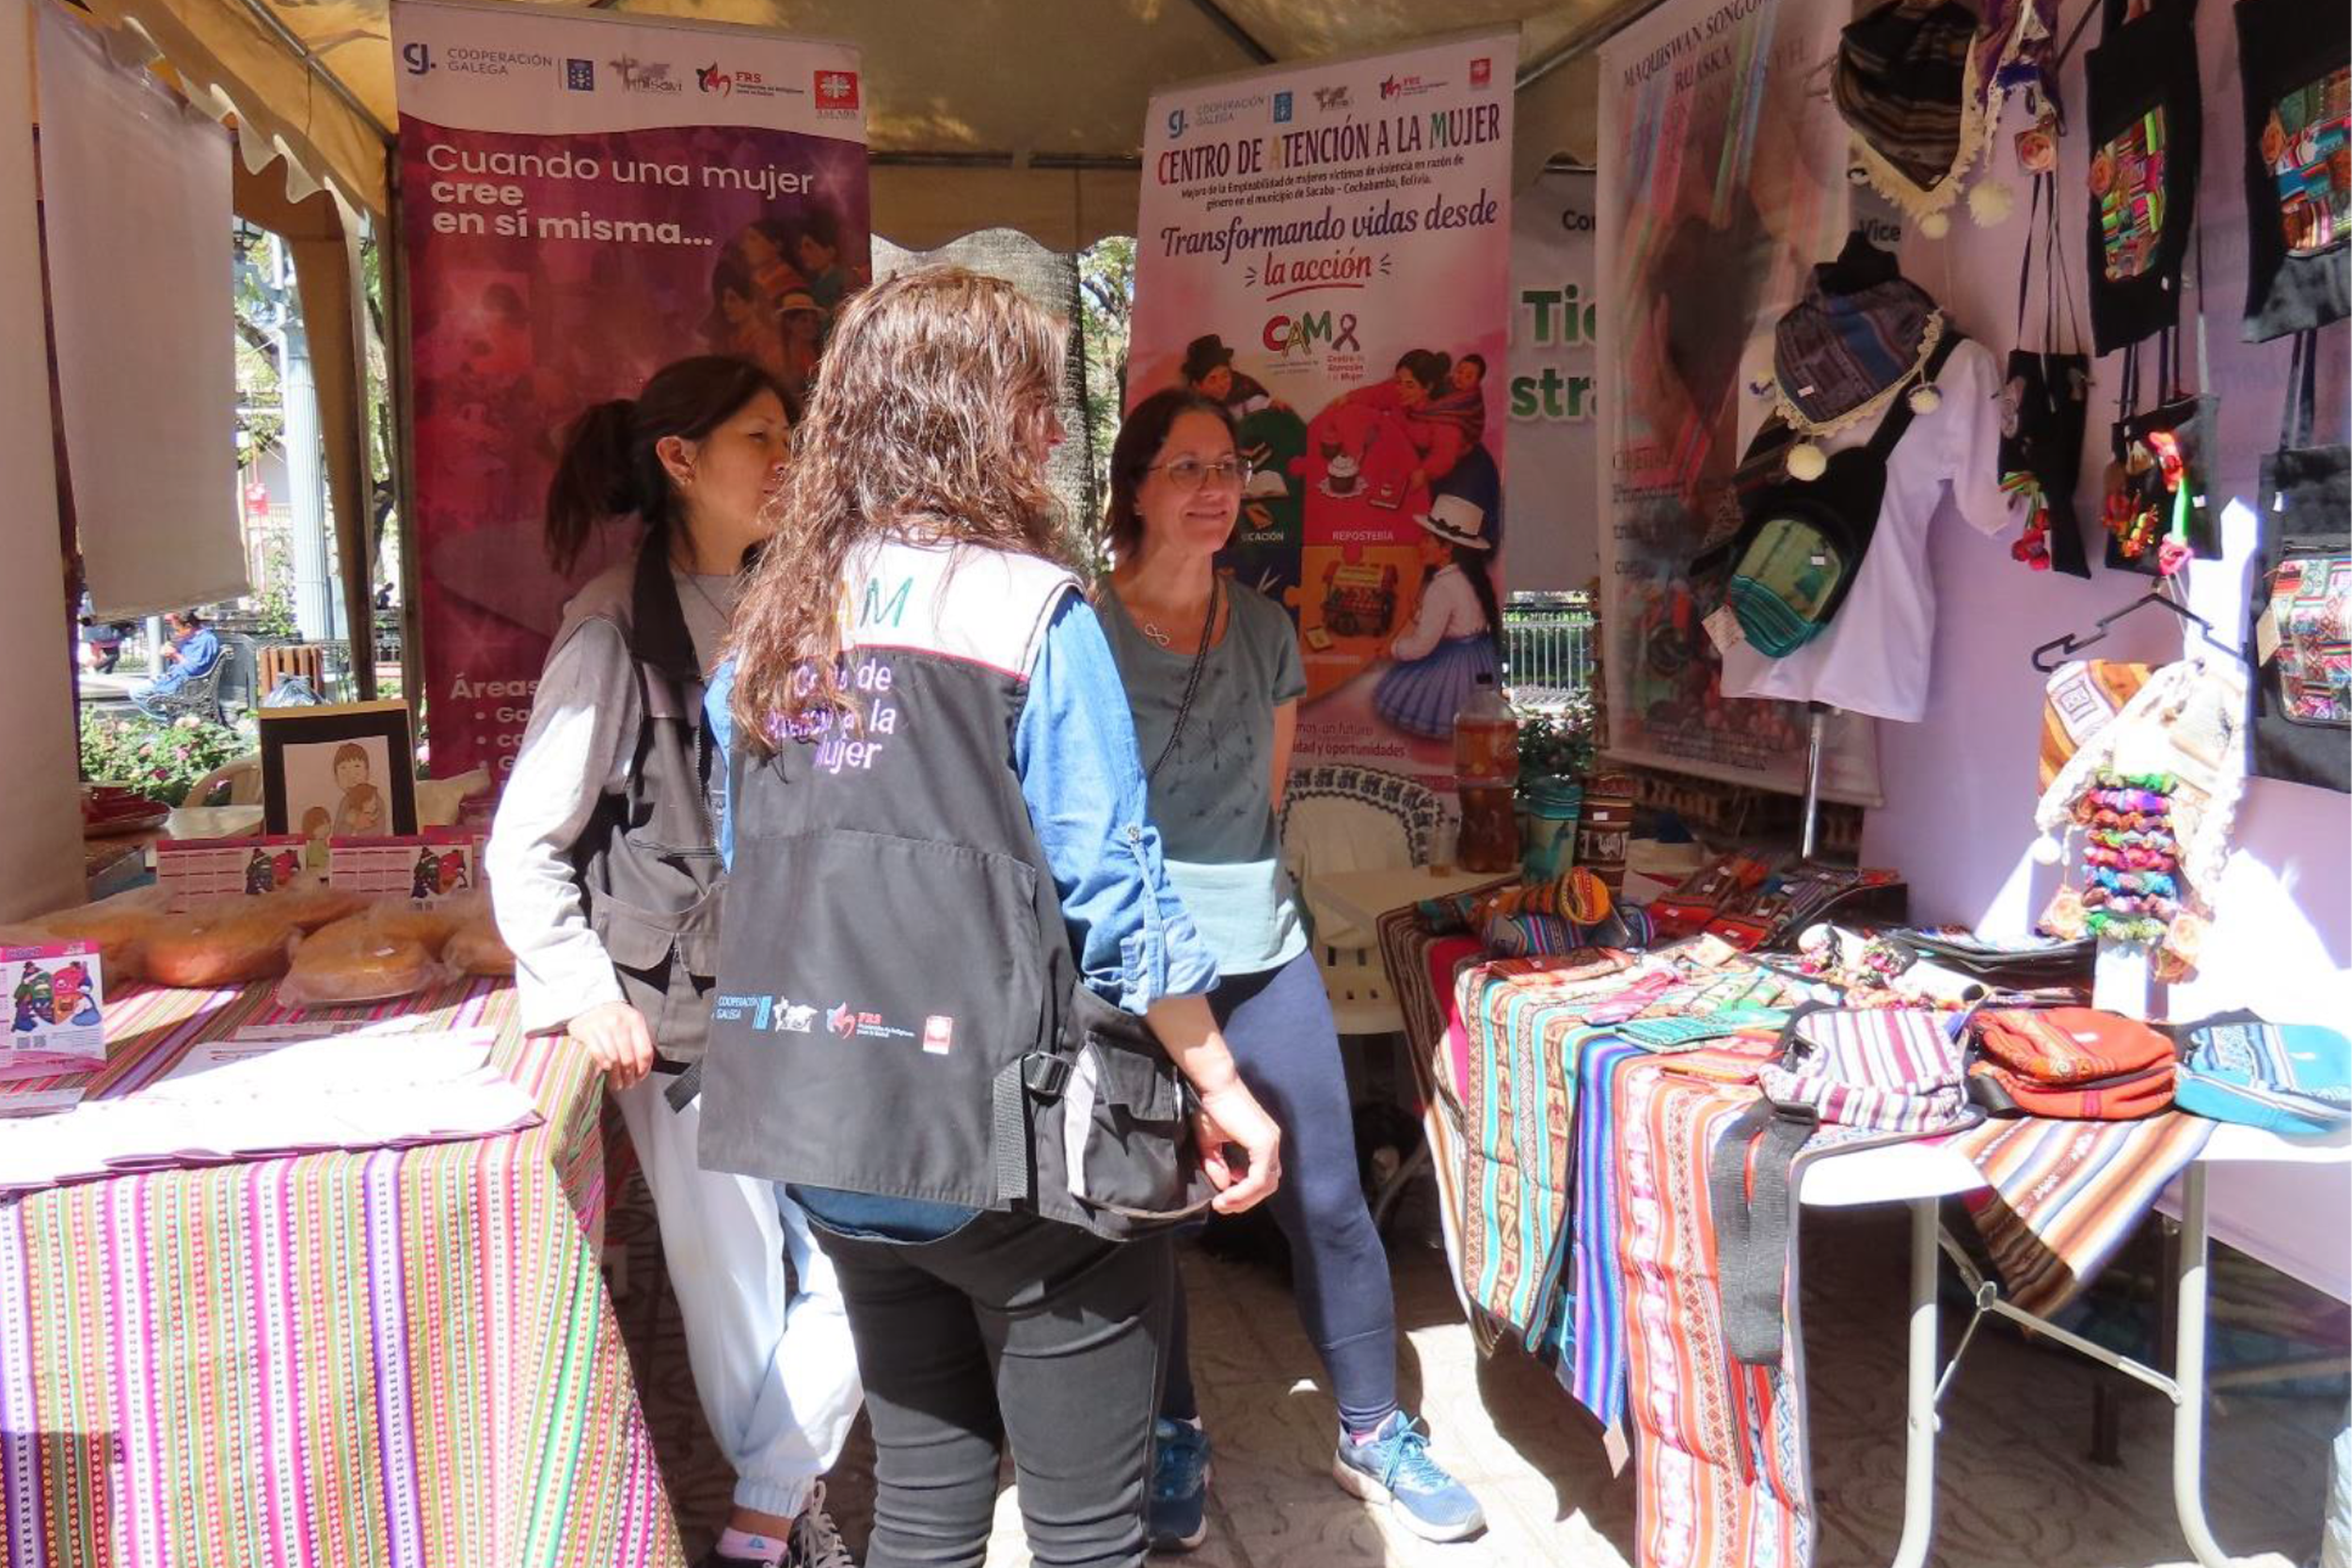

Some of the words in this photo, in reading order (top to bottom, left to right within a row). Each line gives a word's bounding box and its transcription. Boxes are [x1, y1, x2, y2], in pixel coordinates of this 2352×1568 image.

[447, 48, 553, 67] COOPERACIÓN
[448, 62, 509, 75] GALEGA
[736, 71, 762, 84] FRS
[1158, 142, 1230, 185] CENTRO
[1238, 138, 1263, 175] DE
[1270, 114, 1370, 170] ATENCIÓN
[1376, 119, 1391, 157] A
[1397, 115, 1422, 153] LA
[1430, 103, 1501, 150] MUJER
[426, 144, 600, 180] Cuando
[612, 159, 691, 186] una
[703, 163, 815, 200] mujer
[1366, 164, 1375, 176] de
[1415, 161, 1425, 170] en
[1454, 152, 1465, 165] de
[431, 181, 524, 206] cree
[1306, 183, 1335, 198] Sacaba
[432, 212, 485, 235] en
[495, 209, 529, 238] sí
[538, 211, 714, 246] misma...
[1160, 206, 1345, 265] Transformando
[1353, 198, 1418, 238] vidas
[1424, 188, 1499, 230] desde
[1263, 251, 1285, 286] la
[1291, 246, 1372, 282] acción
[1263, 310, 1333, 357] CAM
[1510, 368, 1597, 418] str
[450, 673, 541, 700] Áreas
[857, 657, 893, 691] de
[869, 698, 898, 735] la
[1326, 741, 1406, 758] oportunidades
